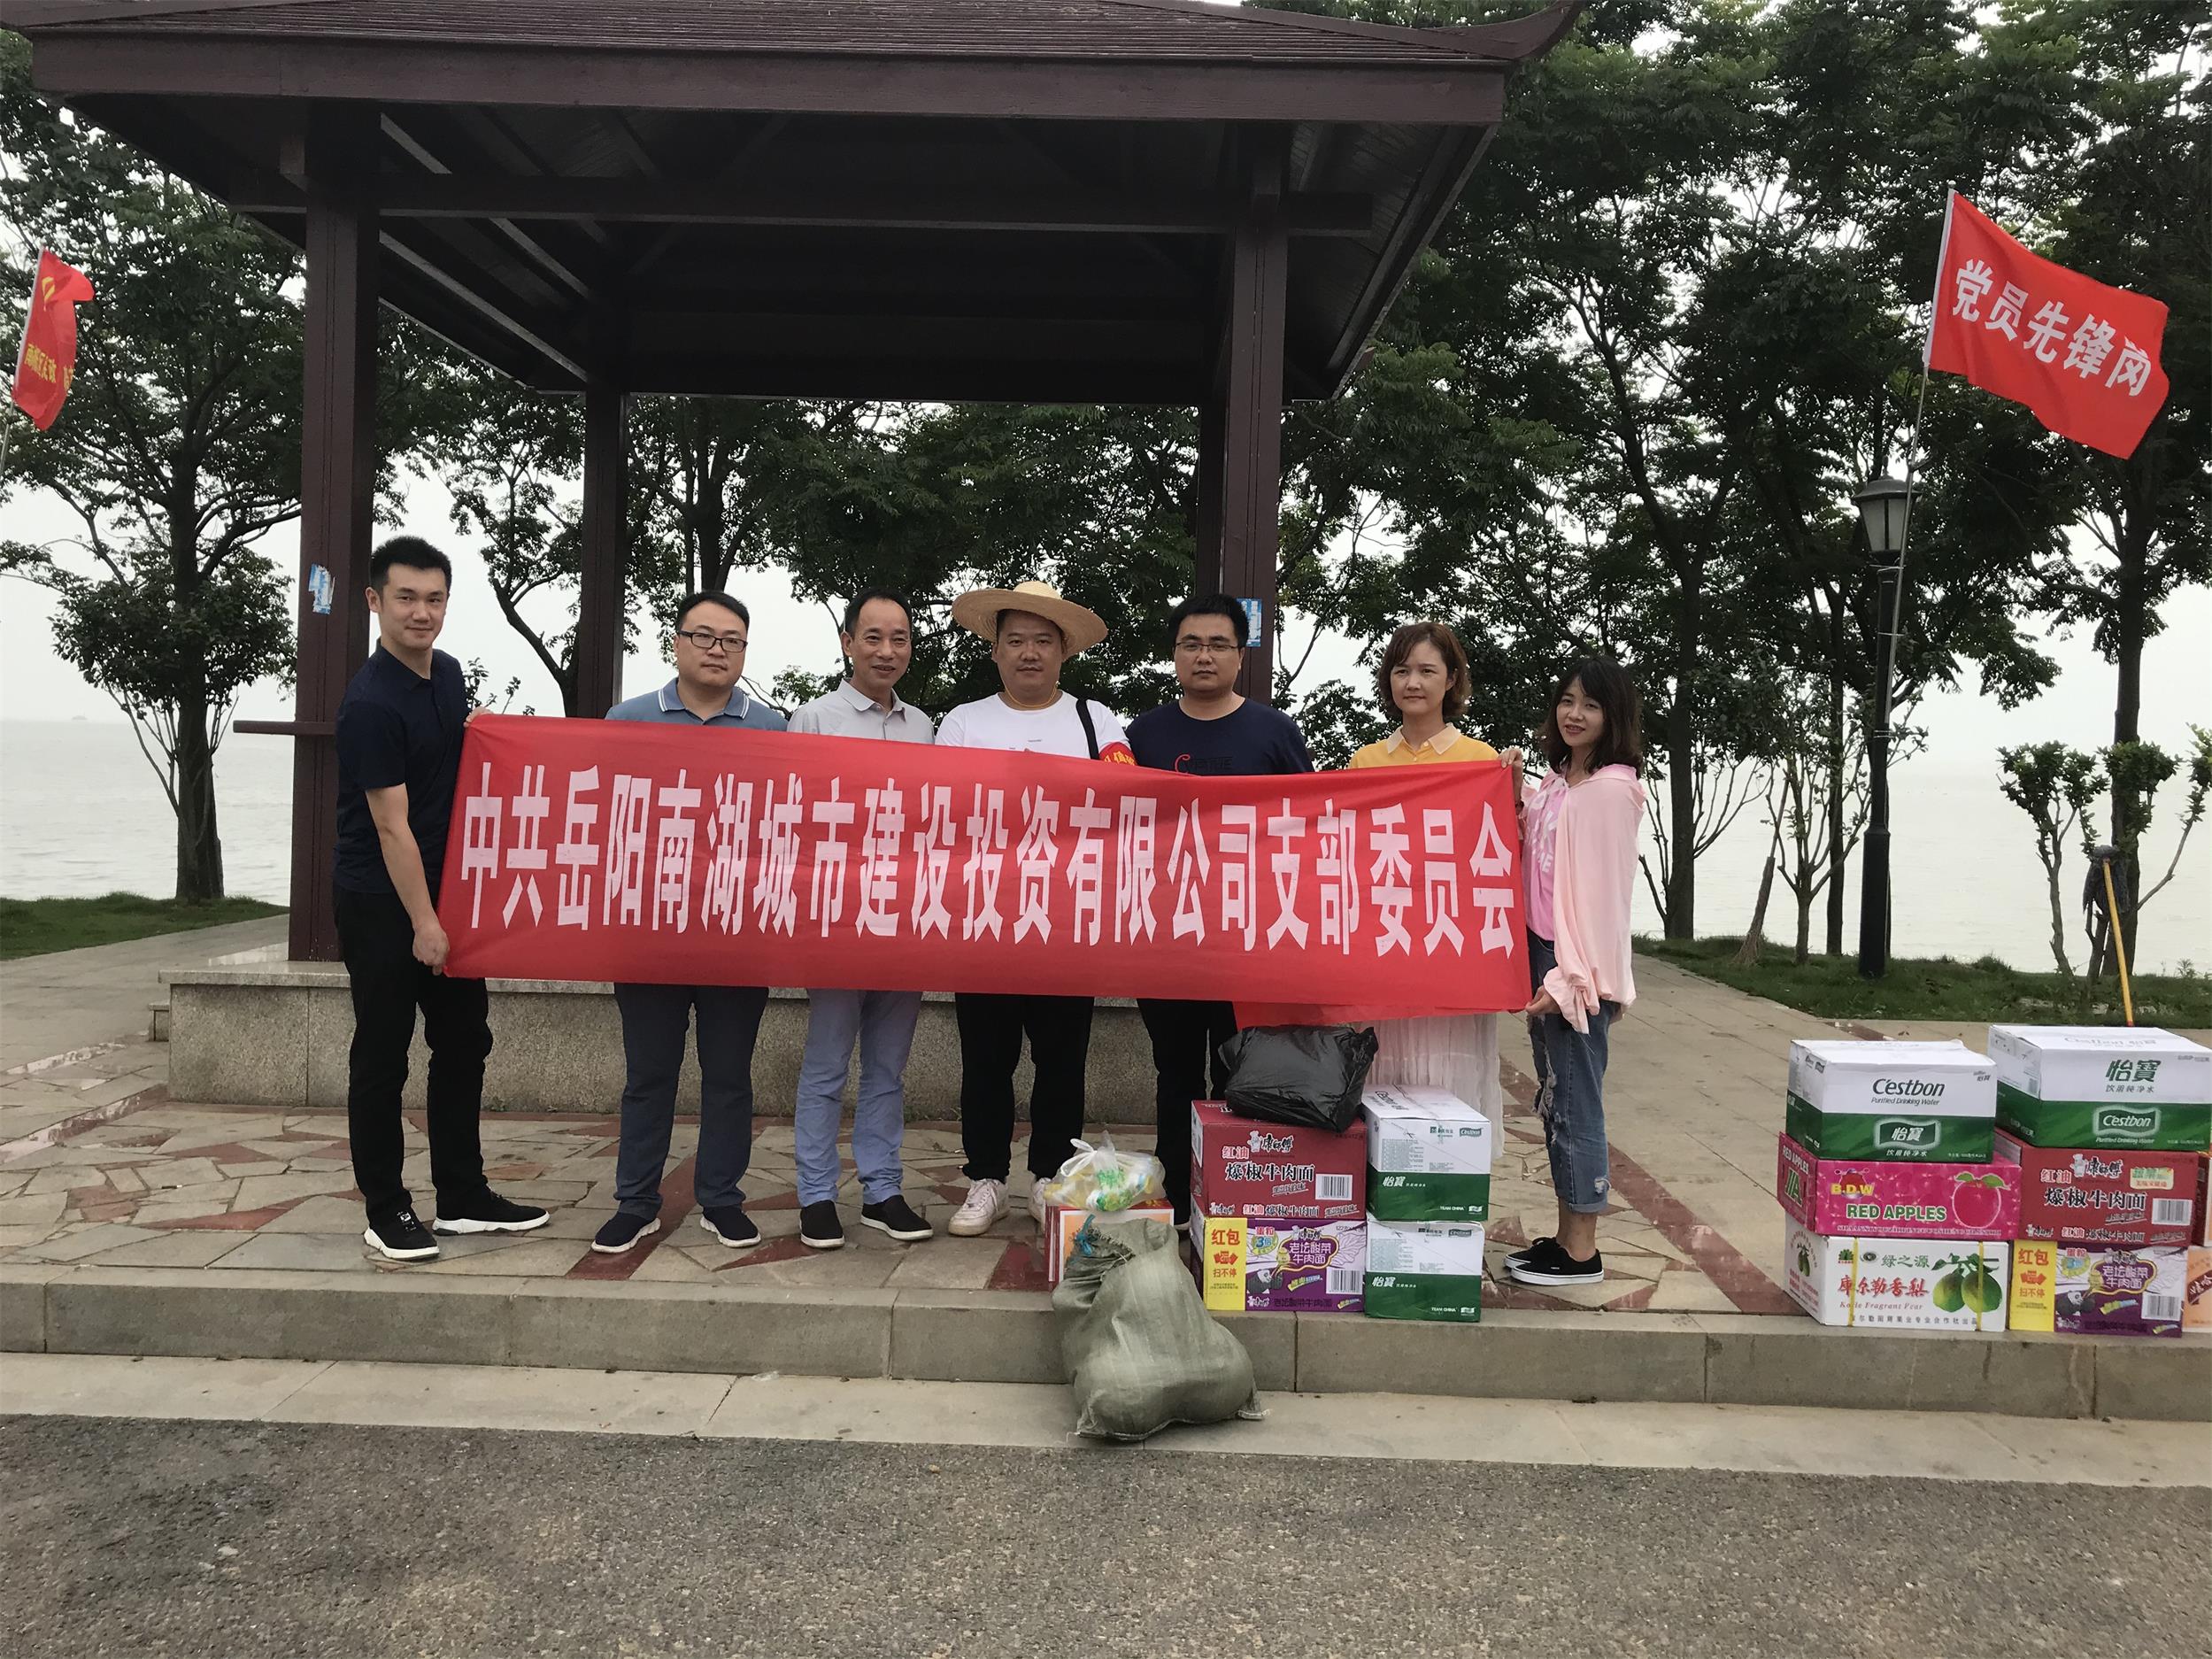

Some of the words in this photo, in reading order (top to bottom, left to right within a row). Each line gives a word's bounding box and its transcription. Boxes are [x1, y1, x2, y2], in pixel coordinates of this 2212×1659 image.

[460, 761, 1514, 960] 中共岳阳南湖城市建设投资有限公司支部委员会
[1895, 1098, 1921, 1107] Drinking
[1222, 1146, 1249, 1160] 红油
[1225, 1162, 1315, 1182] 爆椒牛肉面
[2040, 1169, 2072, 1184] 红油
[2043, 1189, 2147, 1210] 爆椒牛肉面
[1846, 1204, 1880, 1218] RED
[1884, 1206, 1947, 1222] APPLES
[1211, 1229, 1240, 1246] 红包
[1292, 1254, 1326, 1264] 牛肉面
[1881, 1254, 1930, 1268] 绿之源
[2017, 1248, 2050, 1266] 红包
